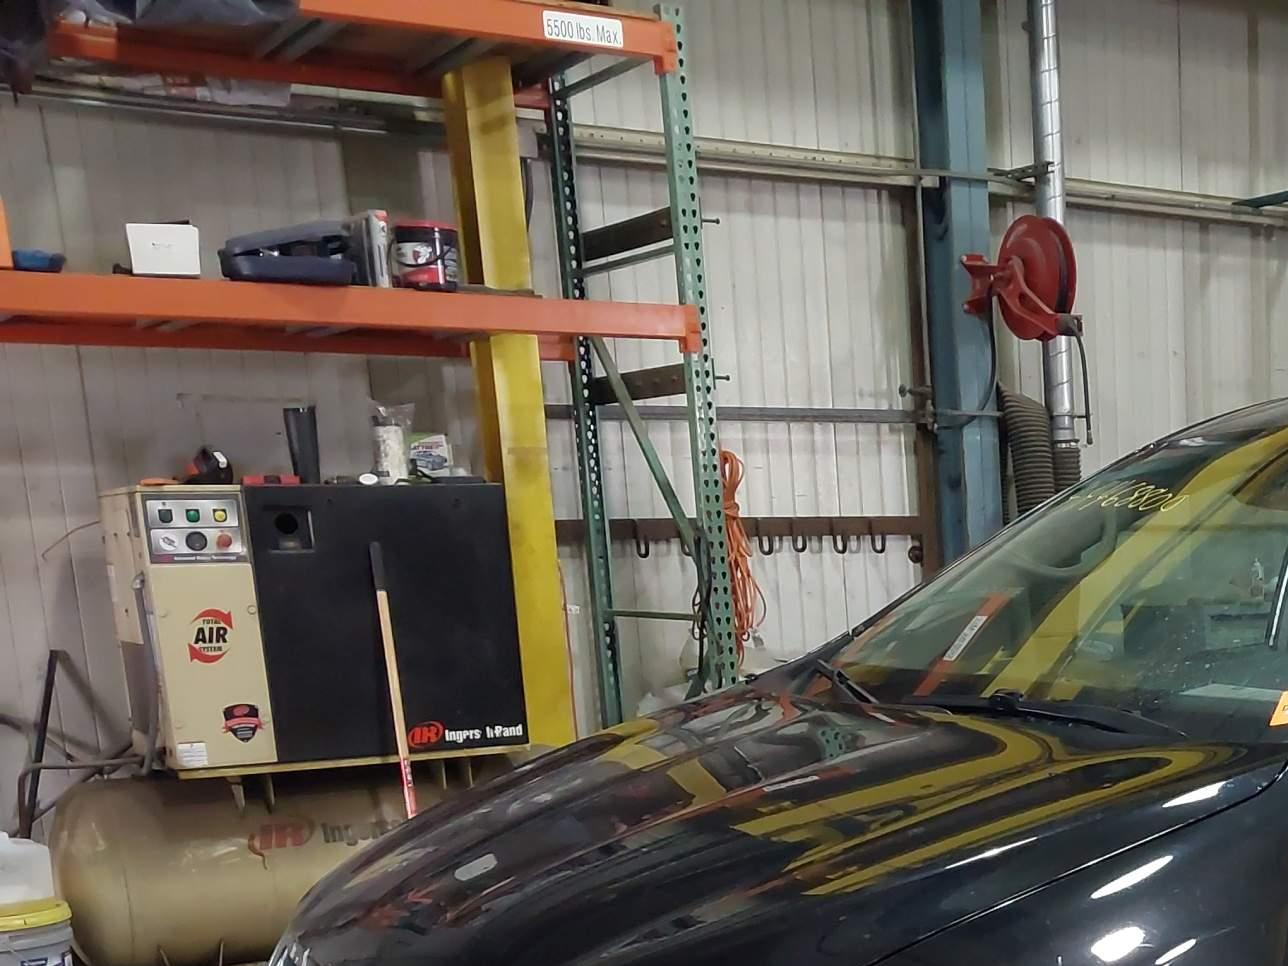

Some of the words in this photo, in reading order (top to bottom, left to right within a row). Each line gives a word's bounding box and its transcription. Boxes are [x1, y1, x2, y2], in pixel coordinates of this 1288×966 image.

[546, 18, 574, 39] 5500
[596, 24, 622, 45] Max.
[194, 626, 228, 644] AIR
